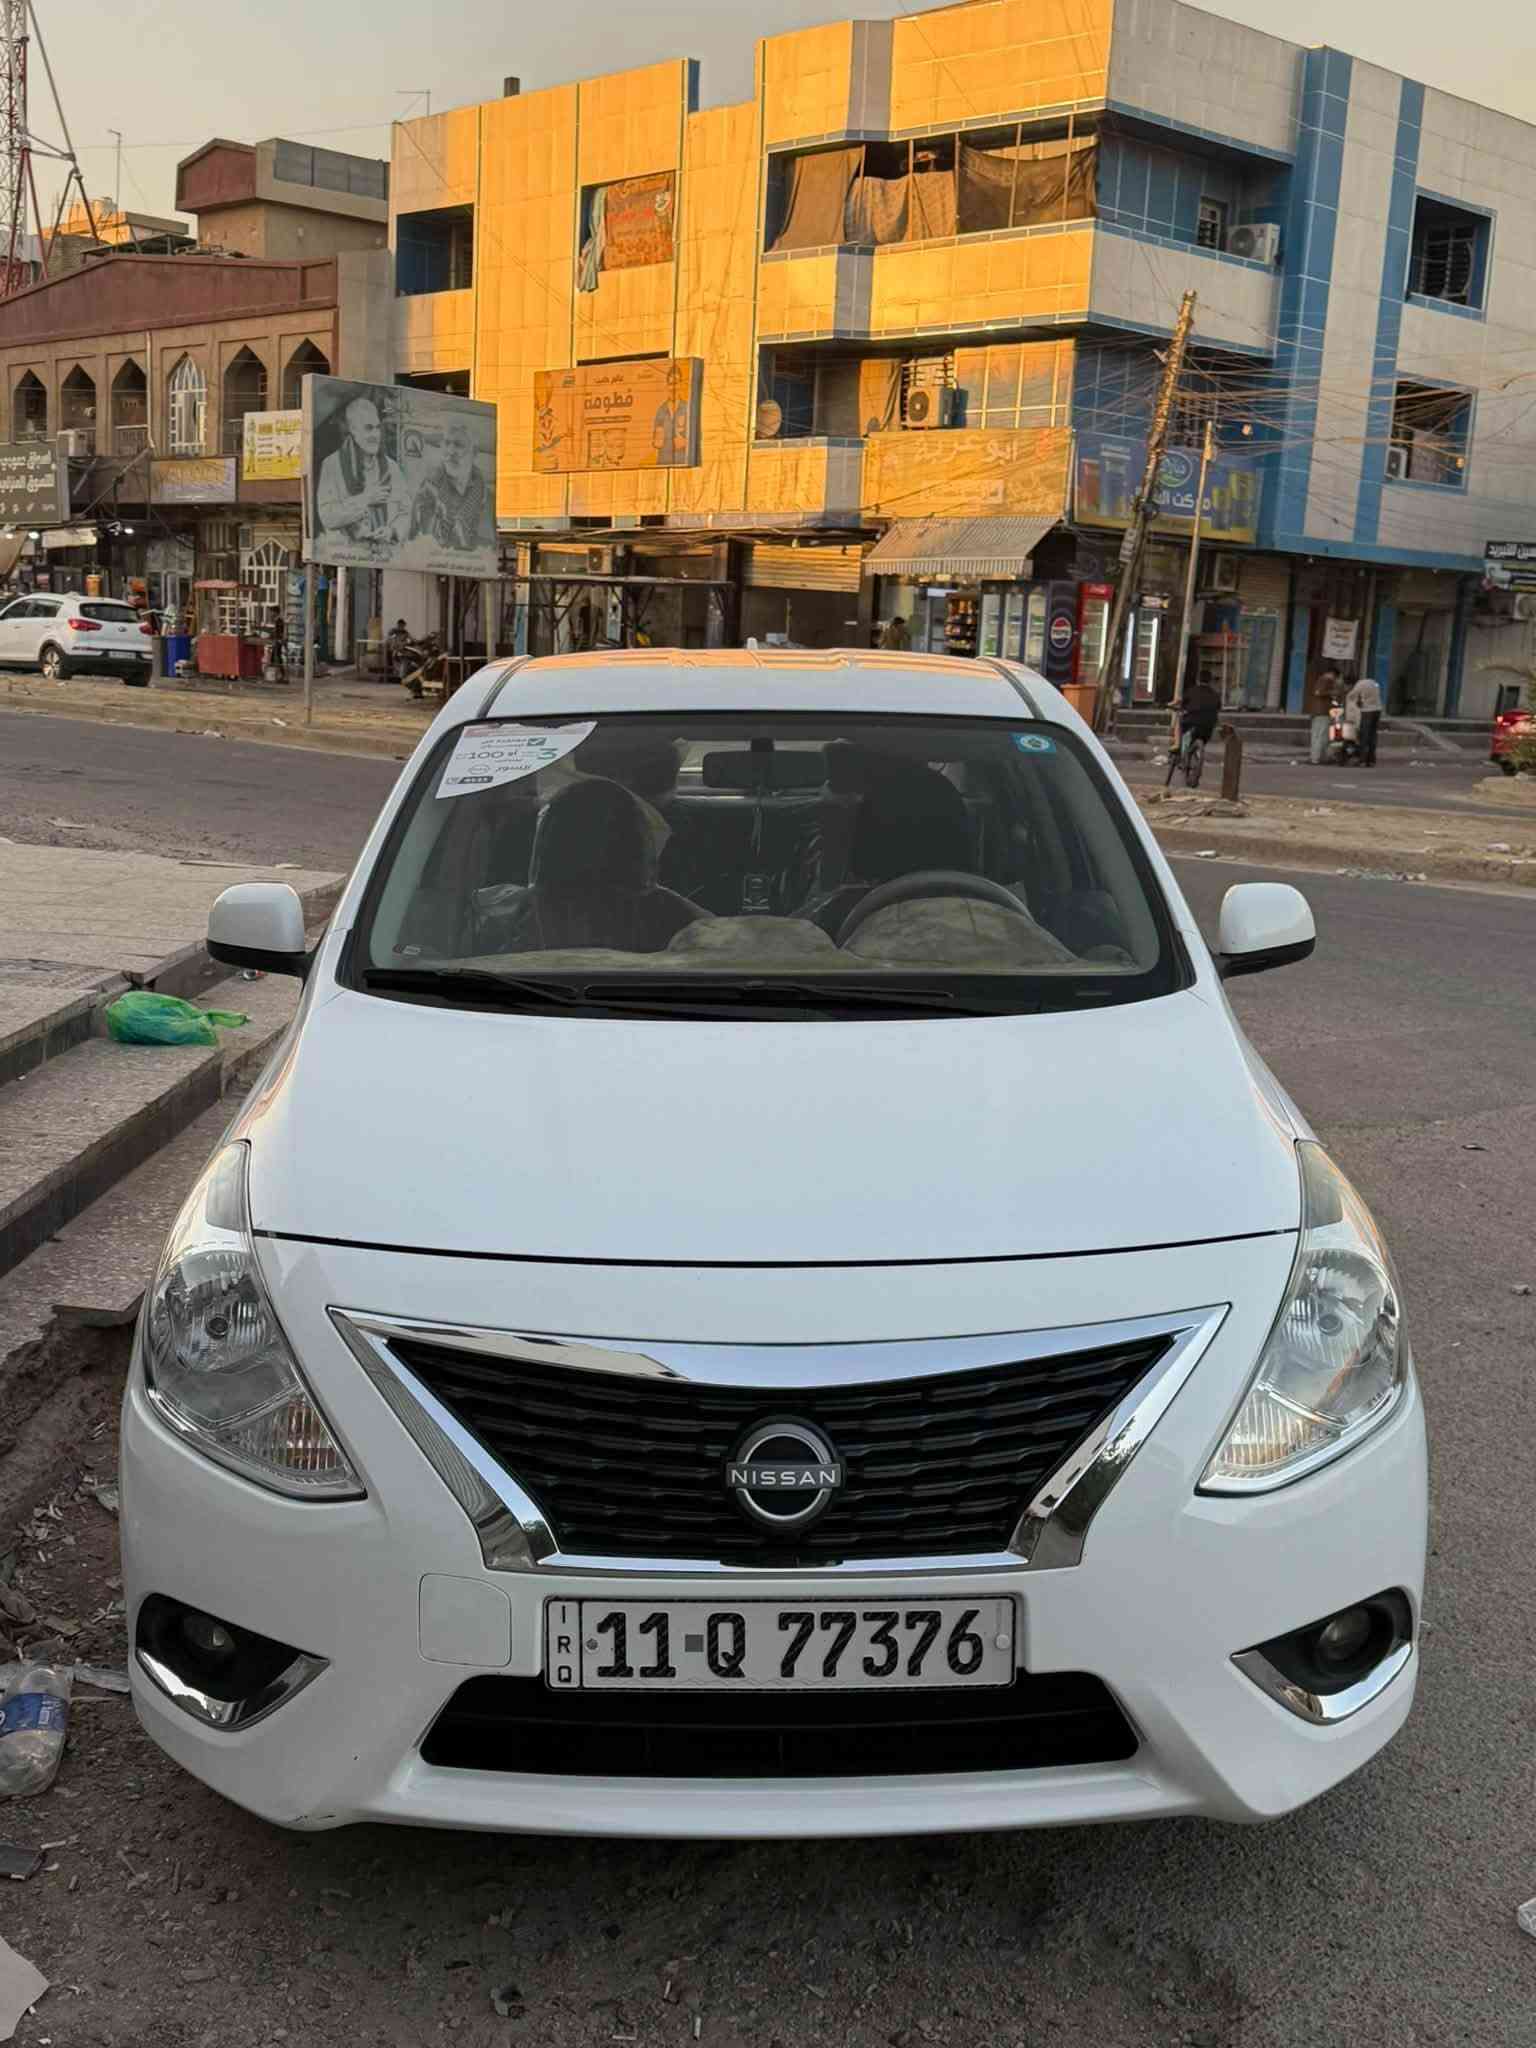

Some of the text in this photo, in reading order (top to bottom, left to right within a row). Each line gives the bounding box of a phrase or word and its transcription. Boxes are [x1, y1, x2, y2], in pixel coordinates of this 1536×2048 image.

[583, 388, 634, 414] فطومة
[468, 751, 504, 760] 100
[536, 747, 559, 761] 3
[731, 1469, 836, 1486] NISSAN
[556, 1605, 572, 1684] IRQ
[596, 1609, 984, 1679] 11 Q 77376
